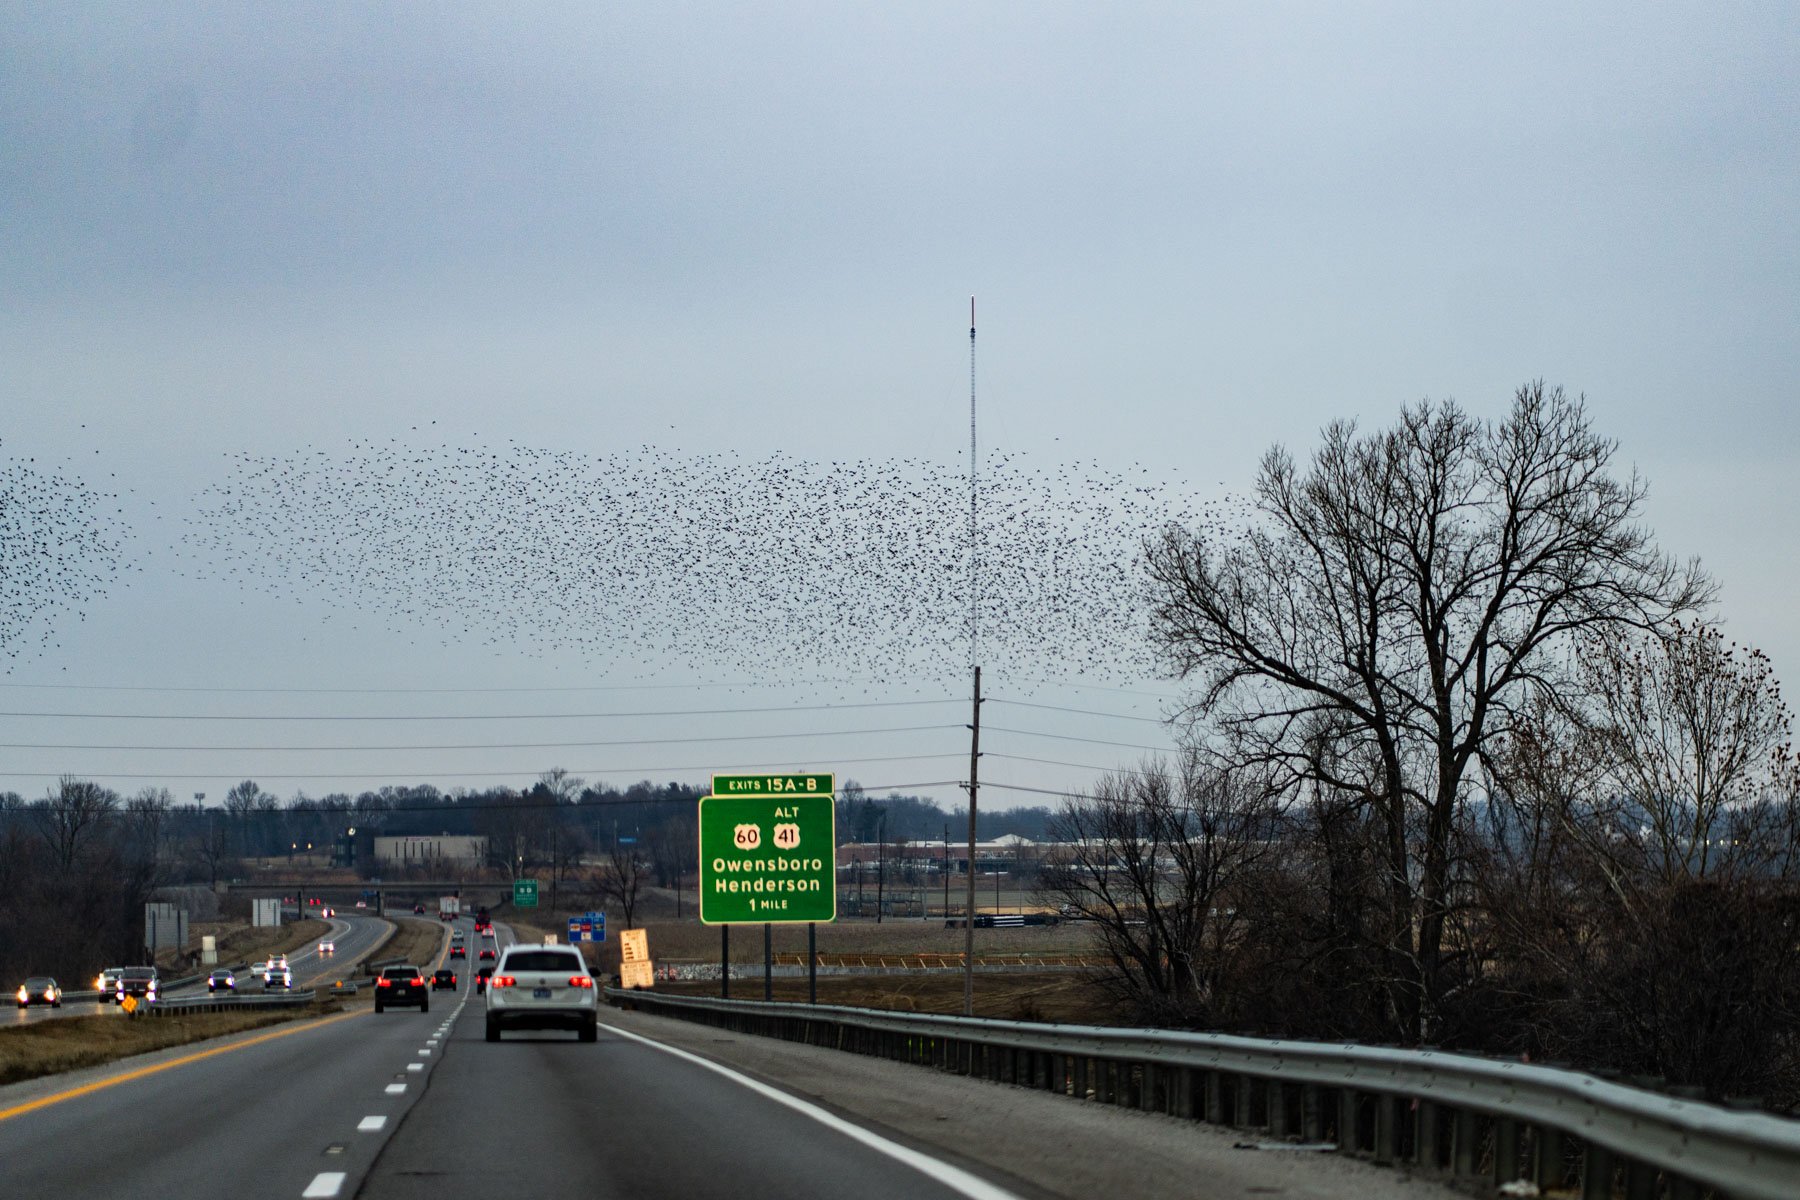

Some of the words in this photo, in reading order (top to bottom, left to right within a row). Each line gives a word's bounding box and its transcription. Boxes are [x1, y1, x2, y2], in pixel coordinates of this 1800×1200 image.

[729, 781, 760, 790] EXITS
[775, 807, 799, 817] ALT
[737, 829, 758, 843] 60
[778, 829, 794, 842] 41
[713, 856, 822, 872] Owensboro
[715, 877, 820, 892] Henderson
[749, 898, 755, 911] 1
[761, 900, 787, 909] MILE
